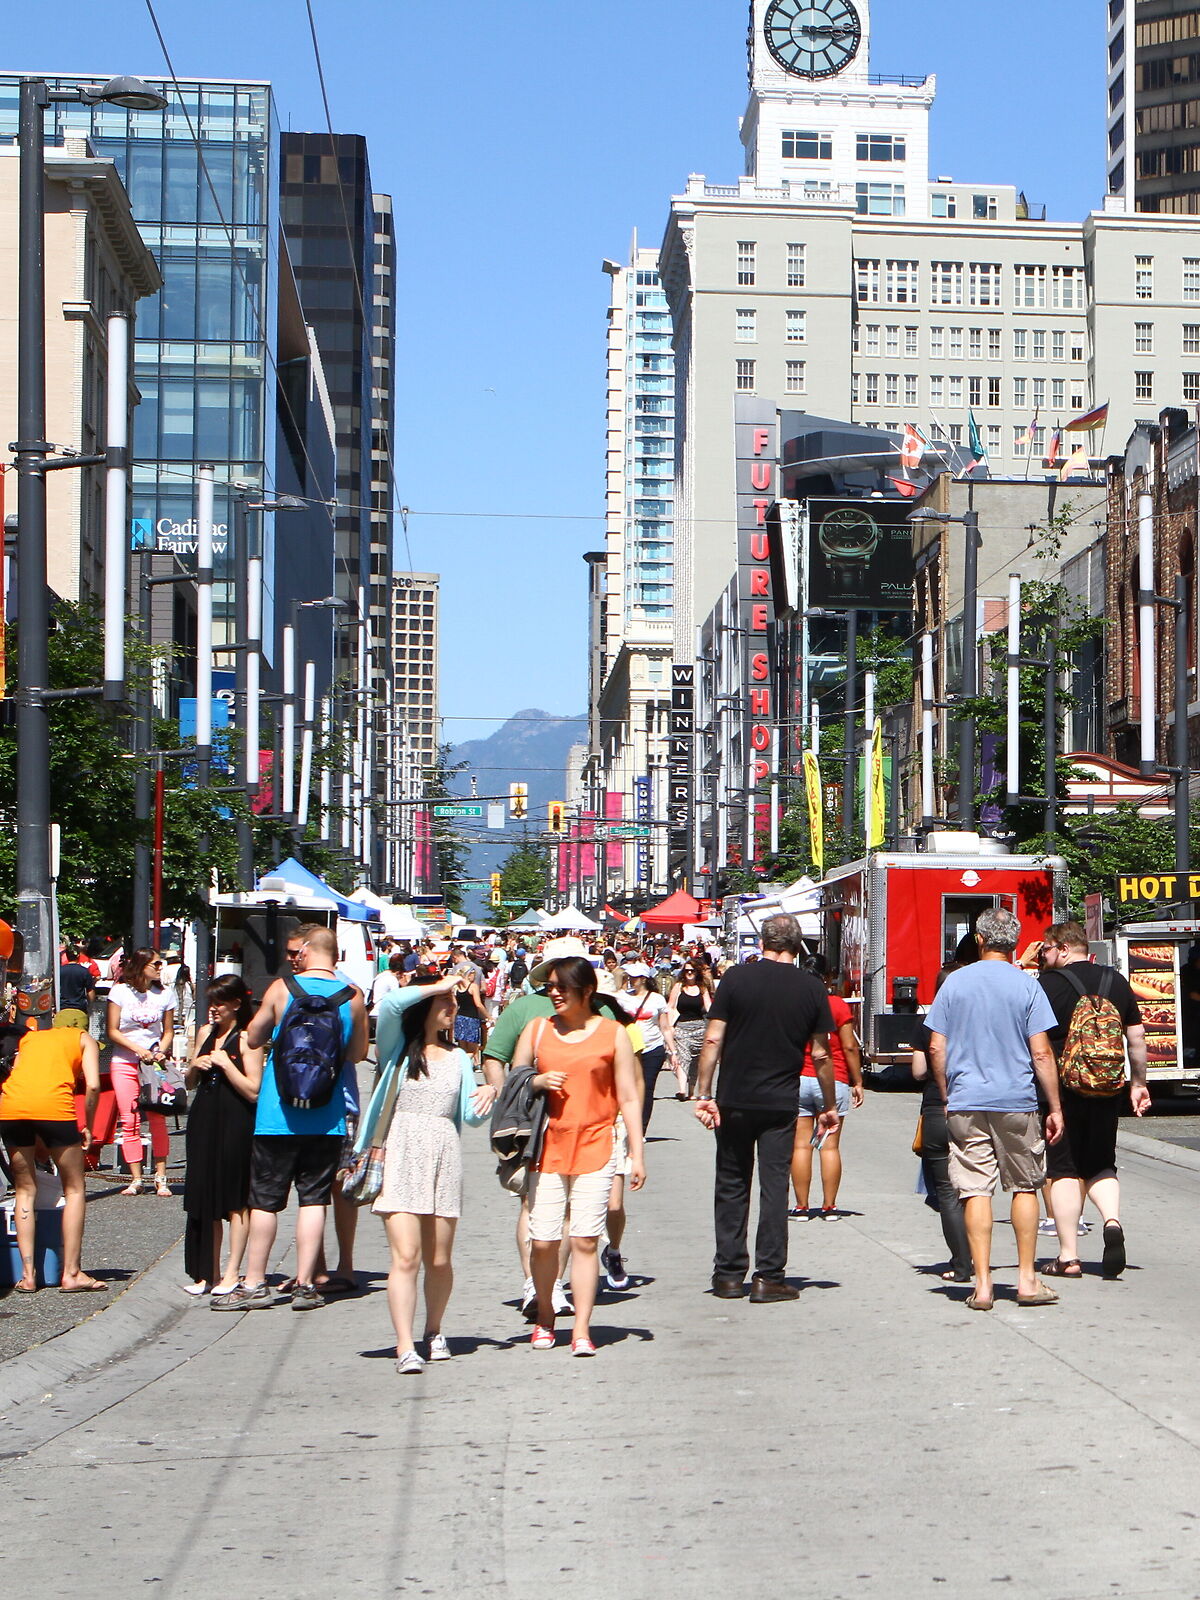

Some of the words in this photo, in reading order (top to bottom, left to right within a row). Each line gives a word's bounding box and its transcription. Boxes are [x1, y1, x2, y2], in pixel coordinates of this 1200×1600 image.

[157, 518, 228, 536] Cadiac
[751, 428, 771, 631] FUTURE
[157, 537, 227, 554] Fairvw
[673, 669, 693, 825] WINNERS
[440, 806, 466, 815] Robson
[468, 806, 476, 815] St
[1120, 876, 1177, 902] HOT
